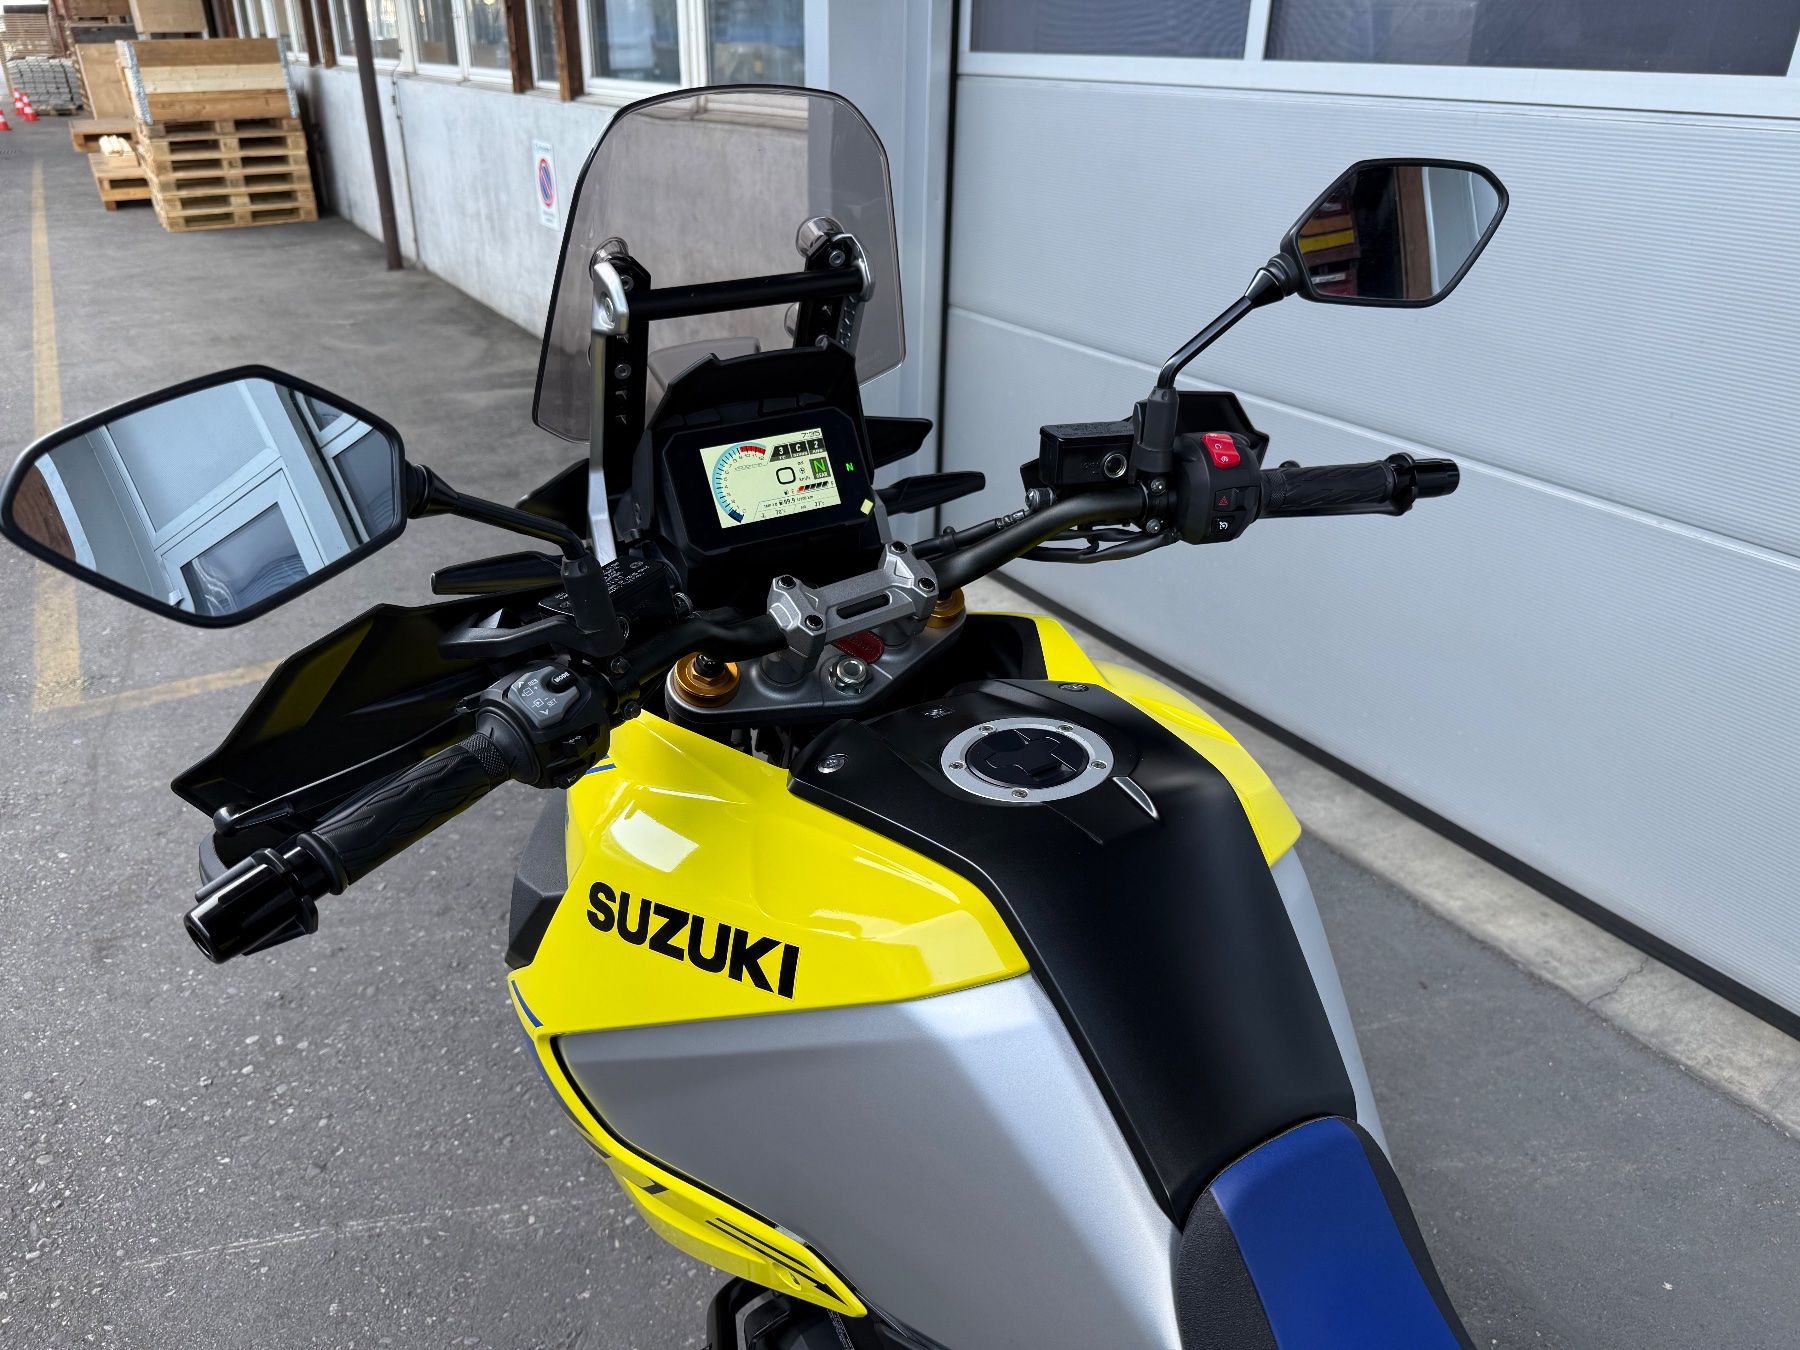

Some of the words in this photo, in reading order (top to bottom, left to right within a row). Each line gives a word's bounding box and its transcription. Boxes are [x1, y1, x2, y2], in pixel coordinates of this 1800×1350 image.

[814, 459, 826, 473] N
[845, 463, 854, 472] N
[554, 672, 570, 682] MODE
[546, 698, 558, 707] SET
[586, 882, 800, 1000] SUZUKI
